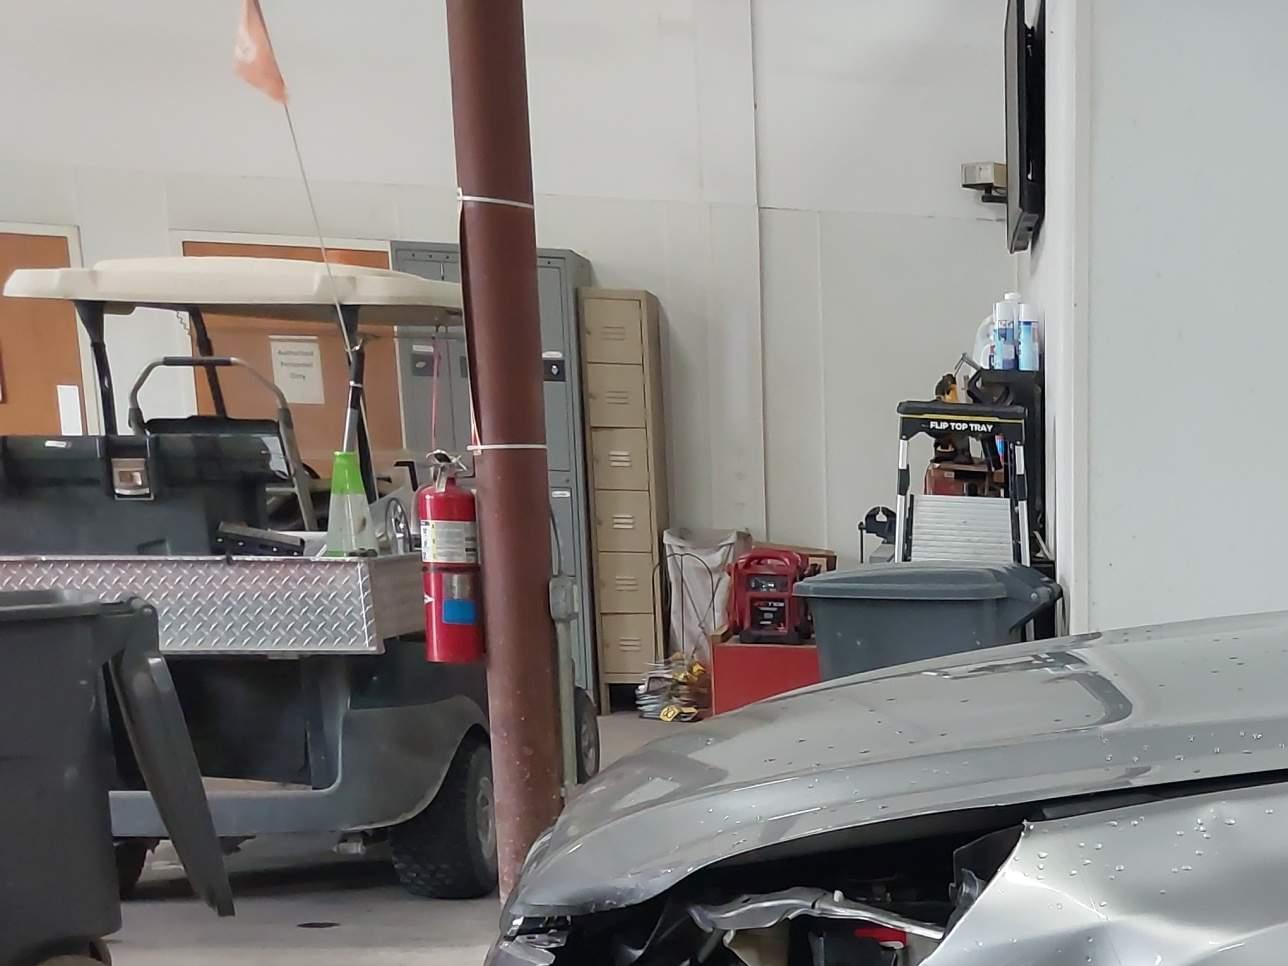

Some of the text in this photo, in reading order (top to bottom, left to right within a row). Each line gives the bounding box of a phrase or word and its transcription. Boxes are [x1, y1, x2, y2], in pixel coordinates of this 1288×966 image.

[929, 421, 949, 430] FLIP
[949, 422, 969, 431] TOP
[969, 423, 994, 433] TRAY
